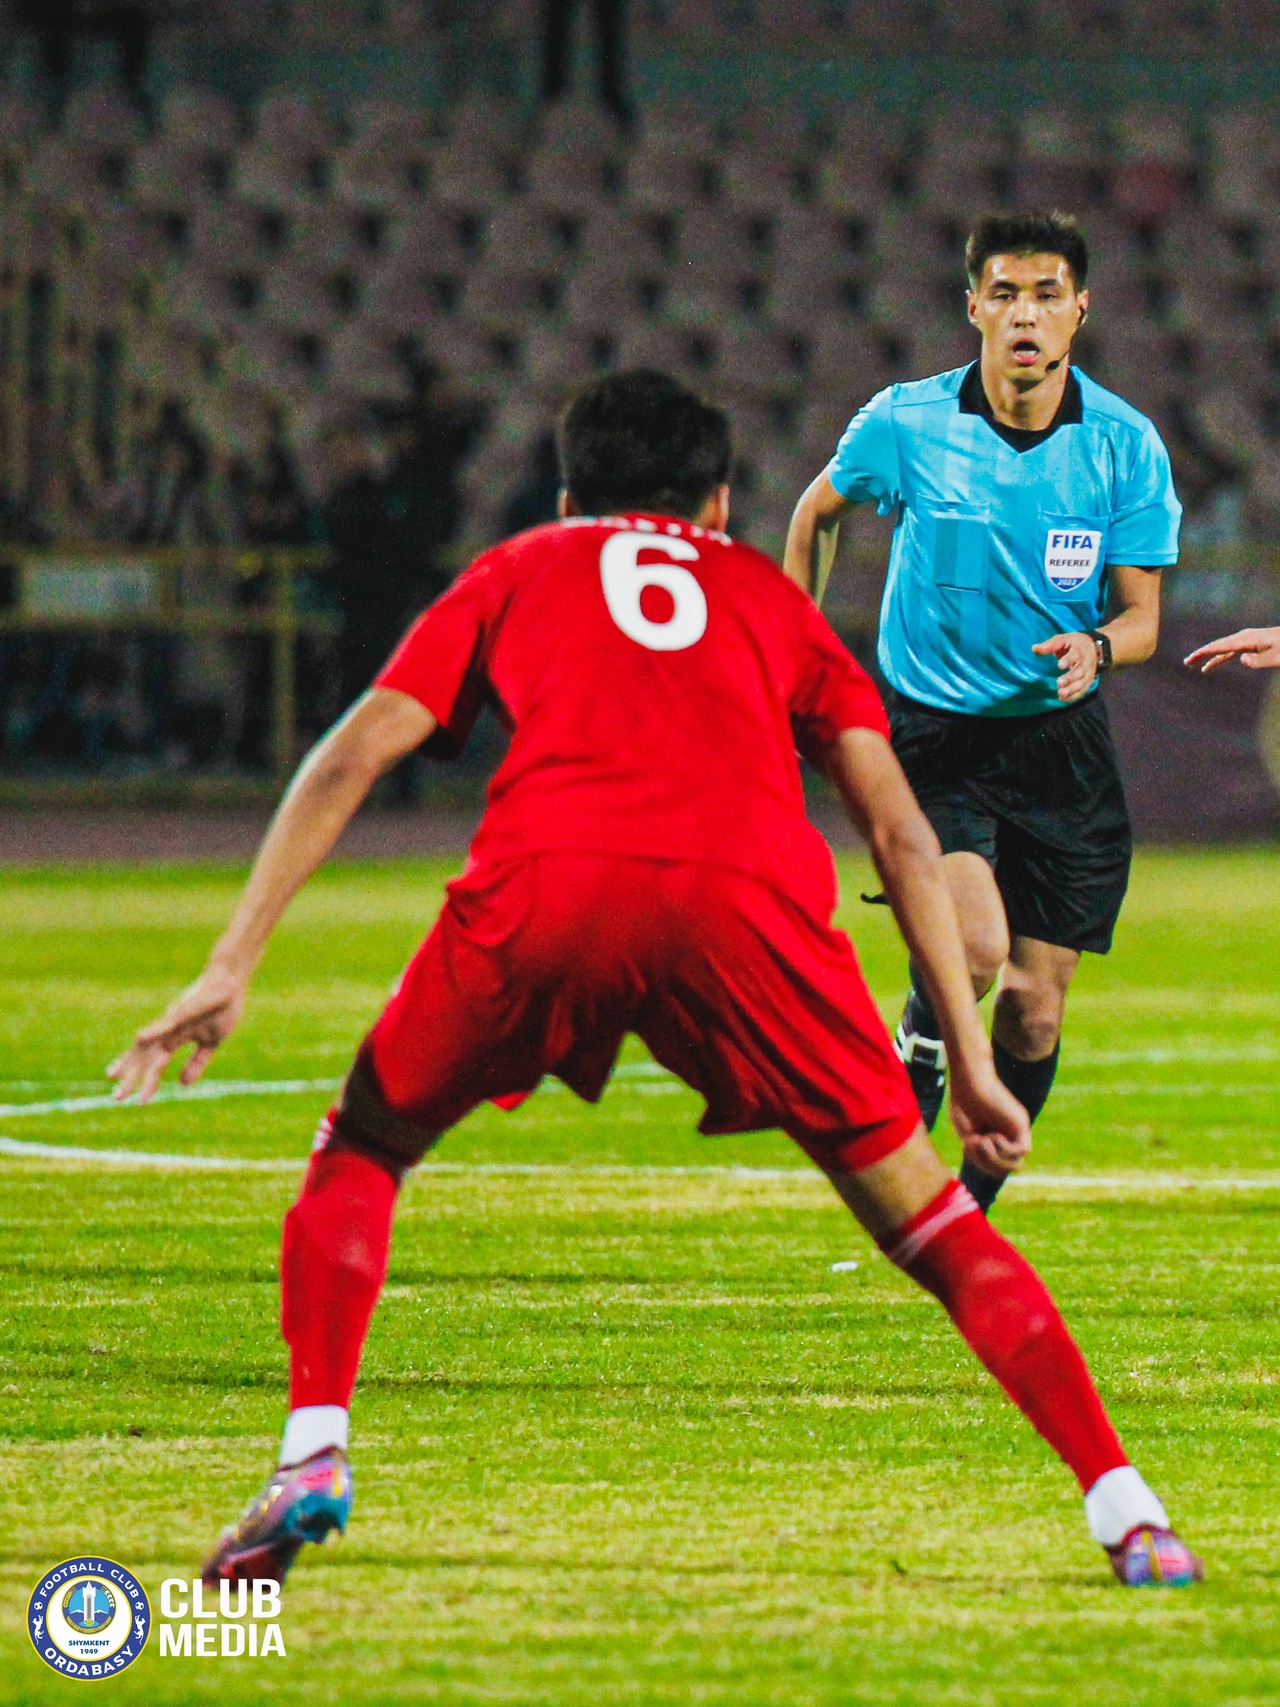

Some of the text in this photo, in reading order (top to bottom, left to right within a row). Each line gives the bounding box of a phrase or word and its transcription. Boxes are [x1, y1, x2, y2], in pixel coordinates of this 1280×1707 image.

[1051, 534, 1093, 549] FIFA
[1049, 558, 1092, 567] REFEREE
[600, 531, 708, 652] 6
